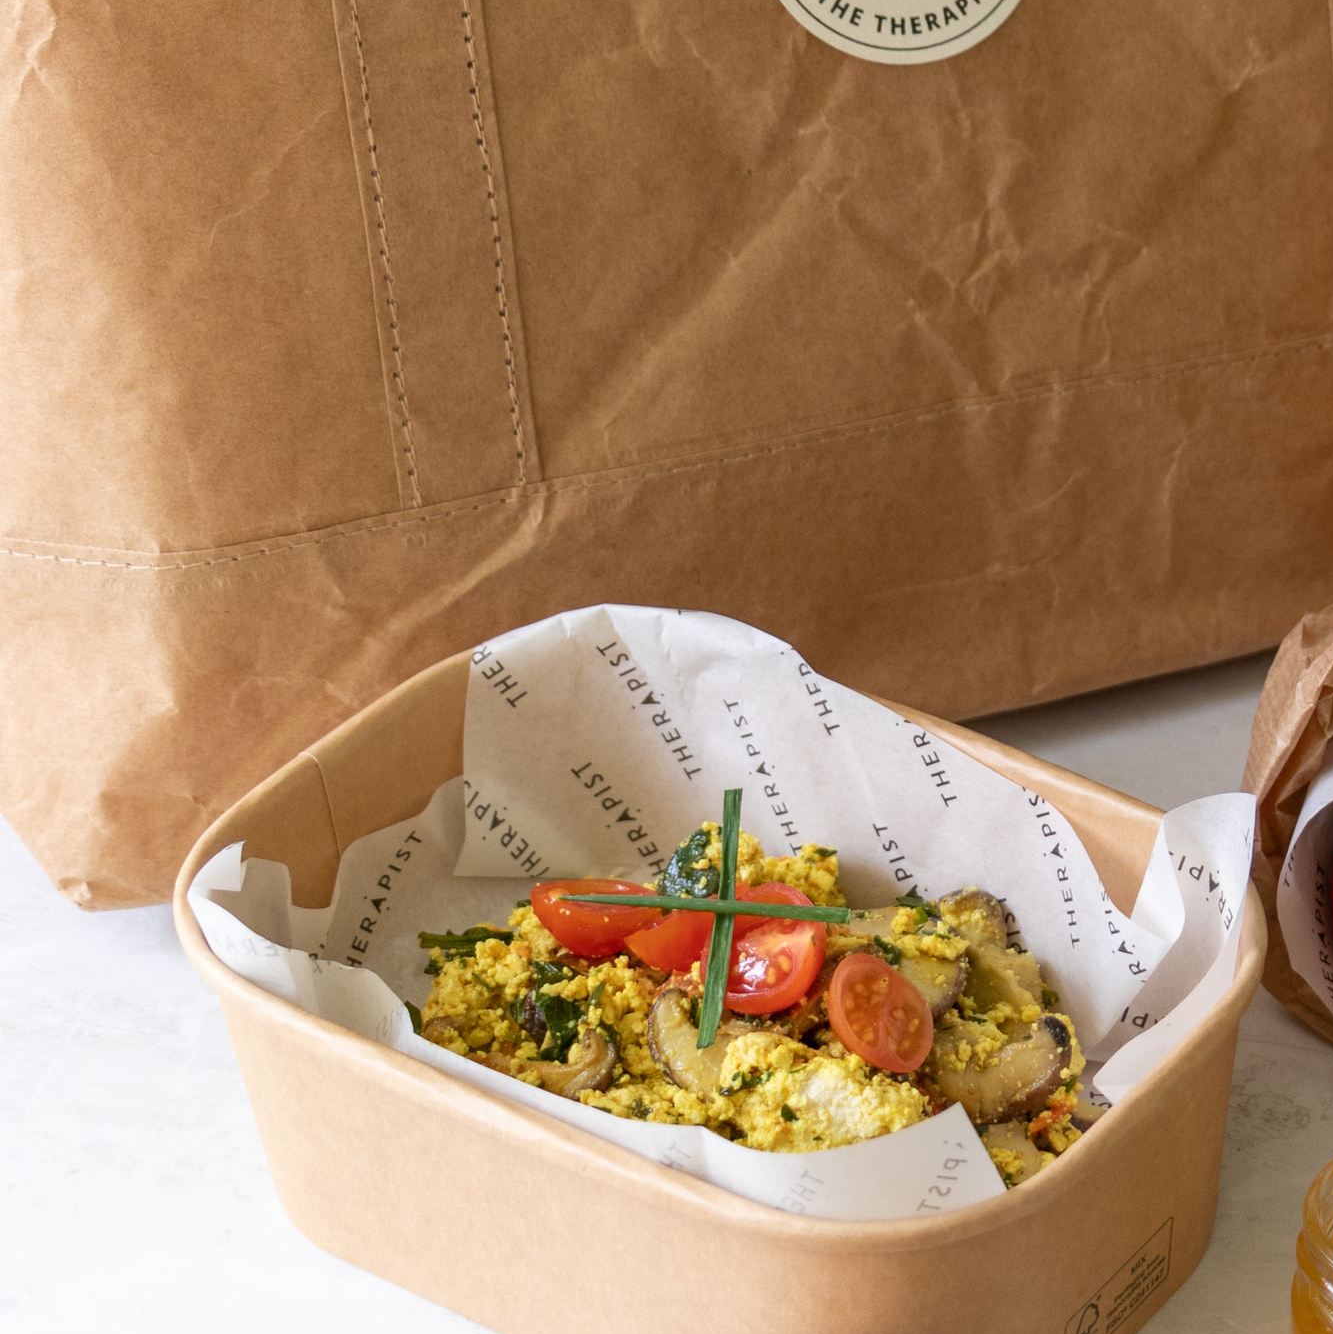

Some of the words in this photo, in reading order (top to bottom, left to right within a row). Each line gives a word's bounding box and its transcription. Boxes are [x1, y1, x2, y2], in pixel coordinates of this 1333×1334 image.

[596, 641, 702, 780] THERAPIST
[724, 699, 803, 855] THERAPIST
[570, 762, 670, 877] HERAPIST
[1026, 789, 1080, 948] THERAPIS
[346, 830, 422, 967] HERAPIST
